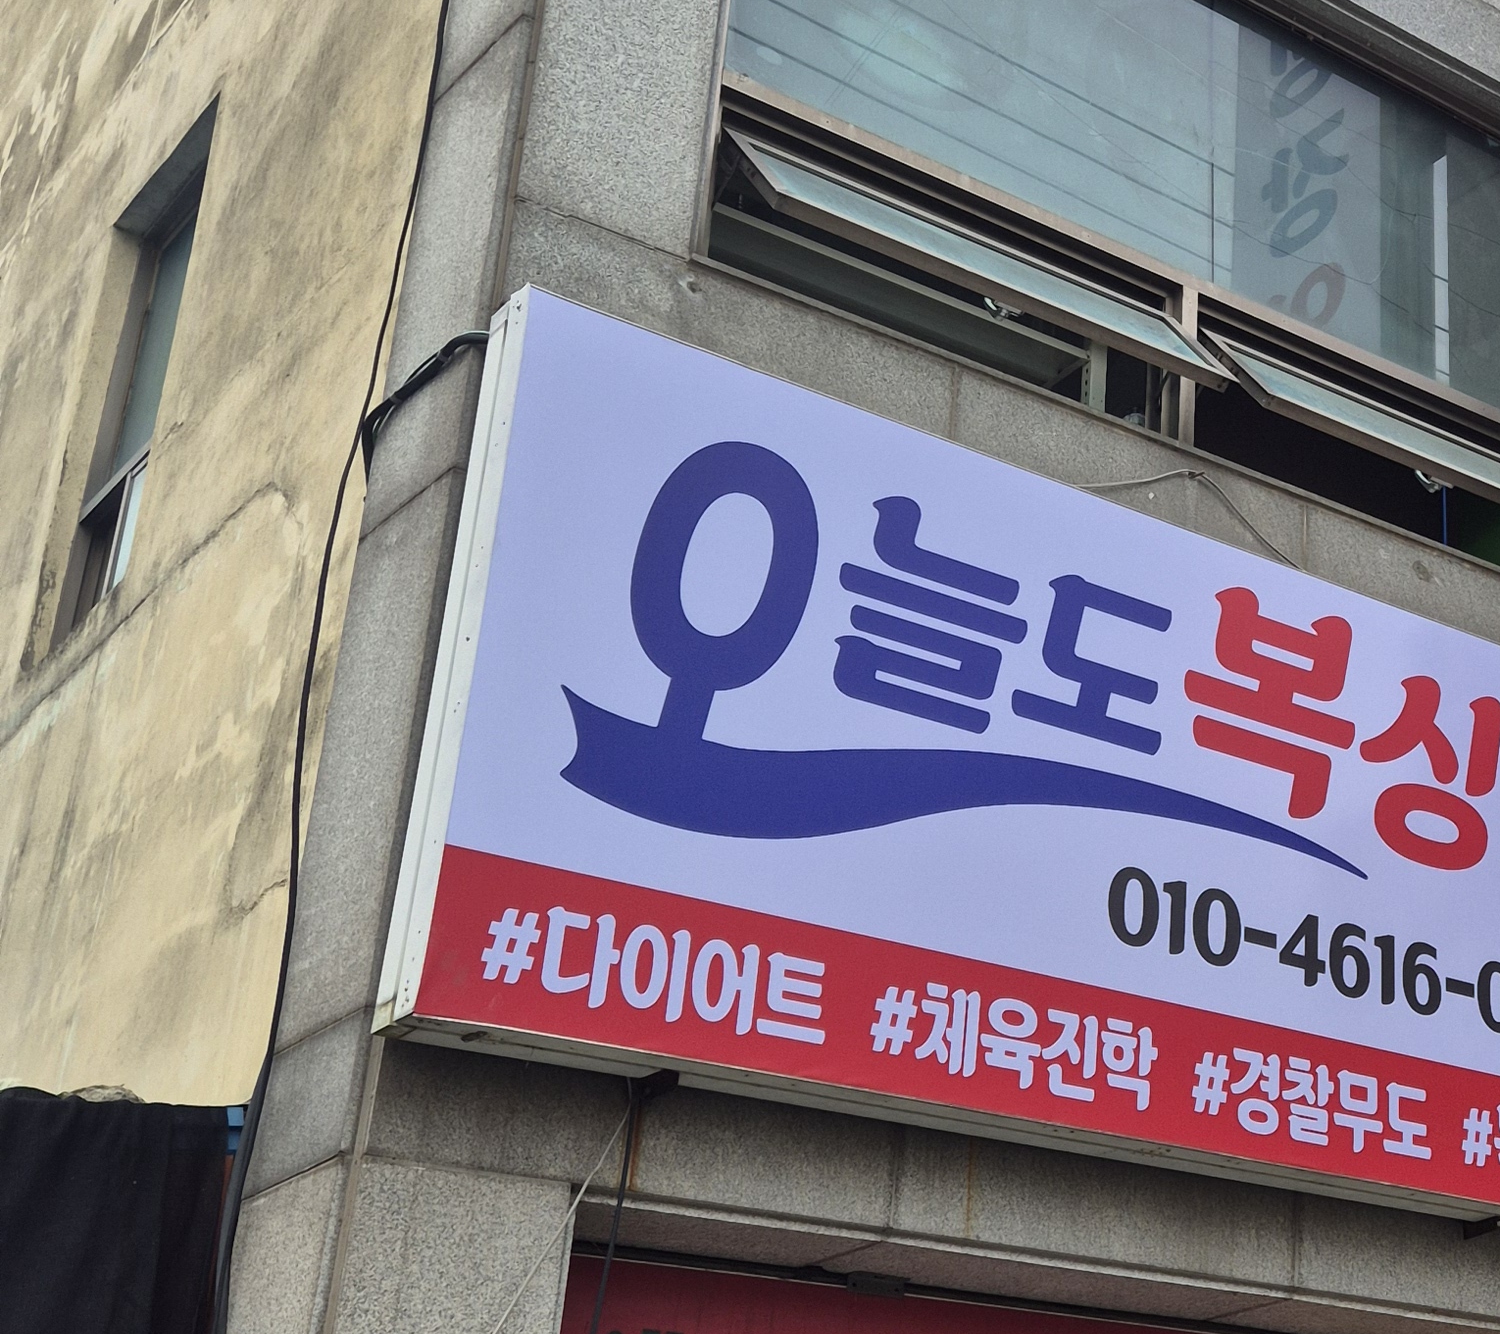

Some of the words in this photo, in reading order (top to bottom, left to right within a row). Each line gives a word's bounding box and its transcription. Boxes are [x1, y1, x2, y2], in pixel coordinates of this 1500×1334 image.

[481, 905, 826, 1045] #다이어트
[870, 982, 1158, 1110] #체육진학
[1192, 1048, 1432, 1159] #경찰무도
